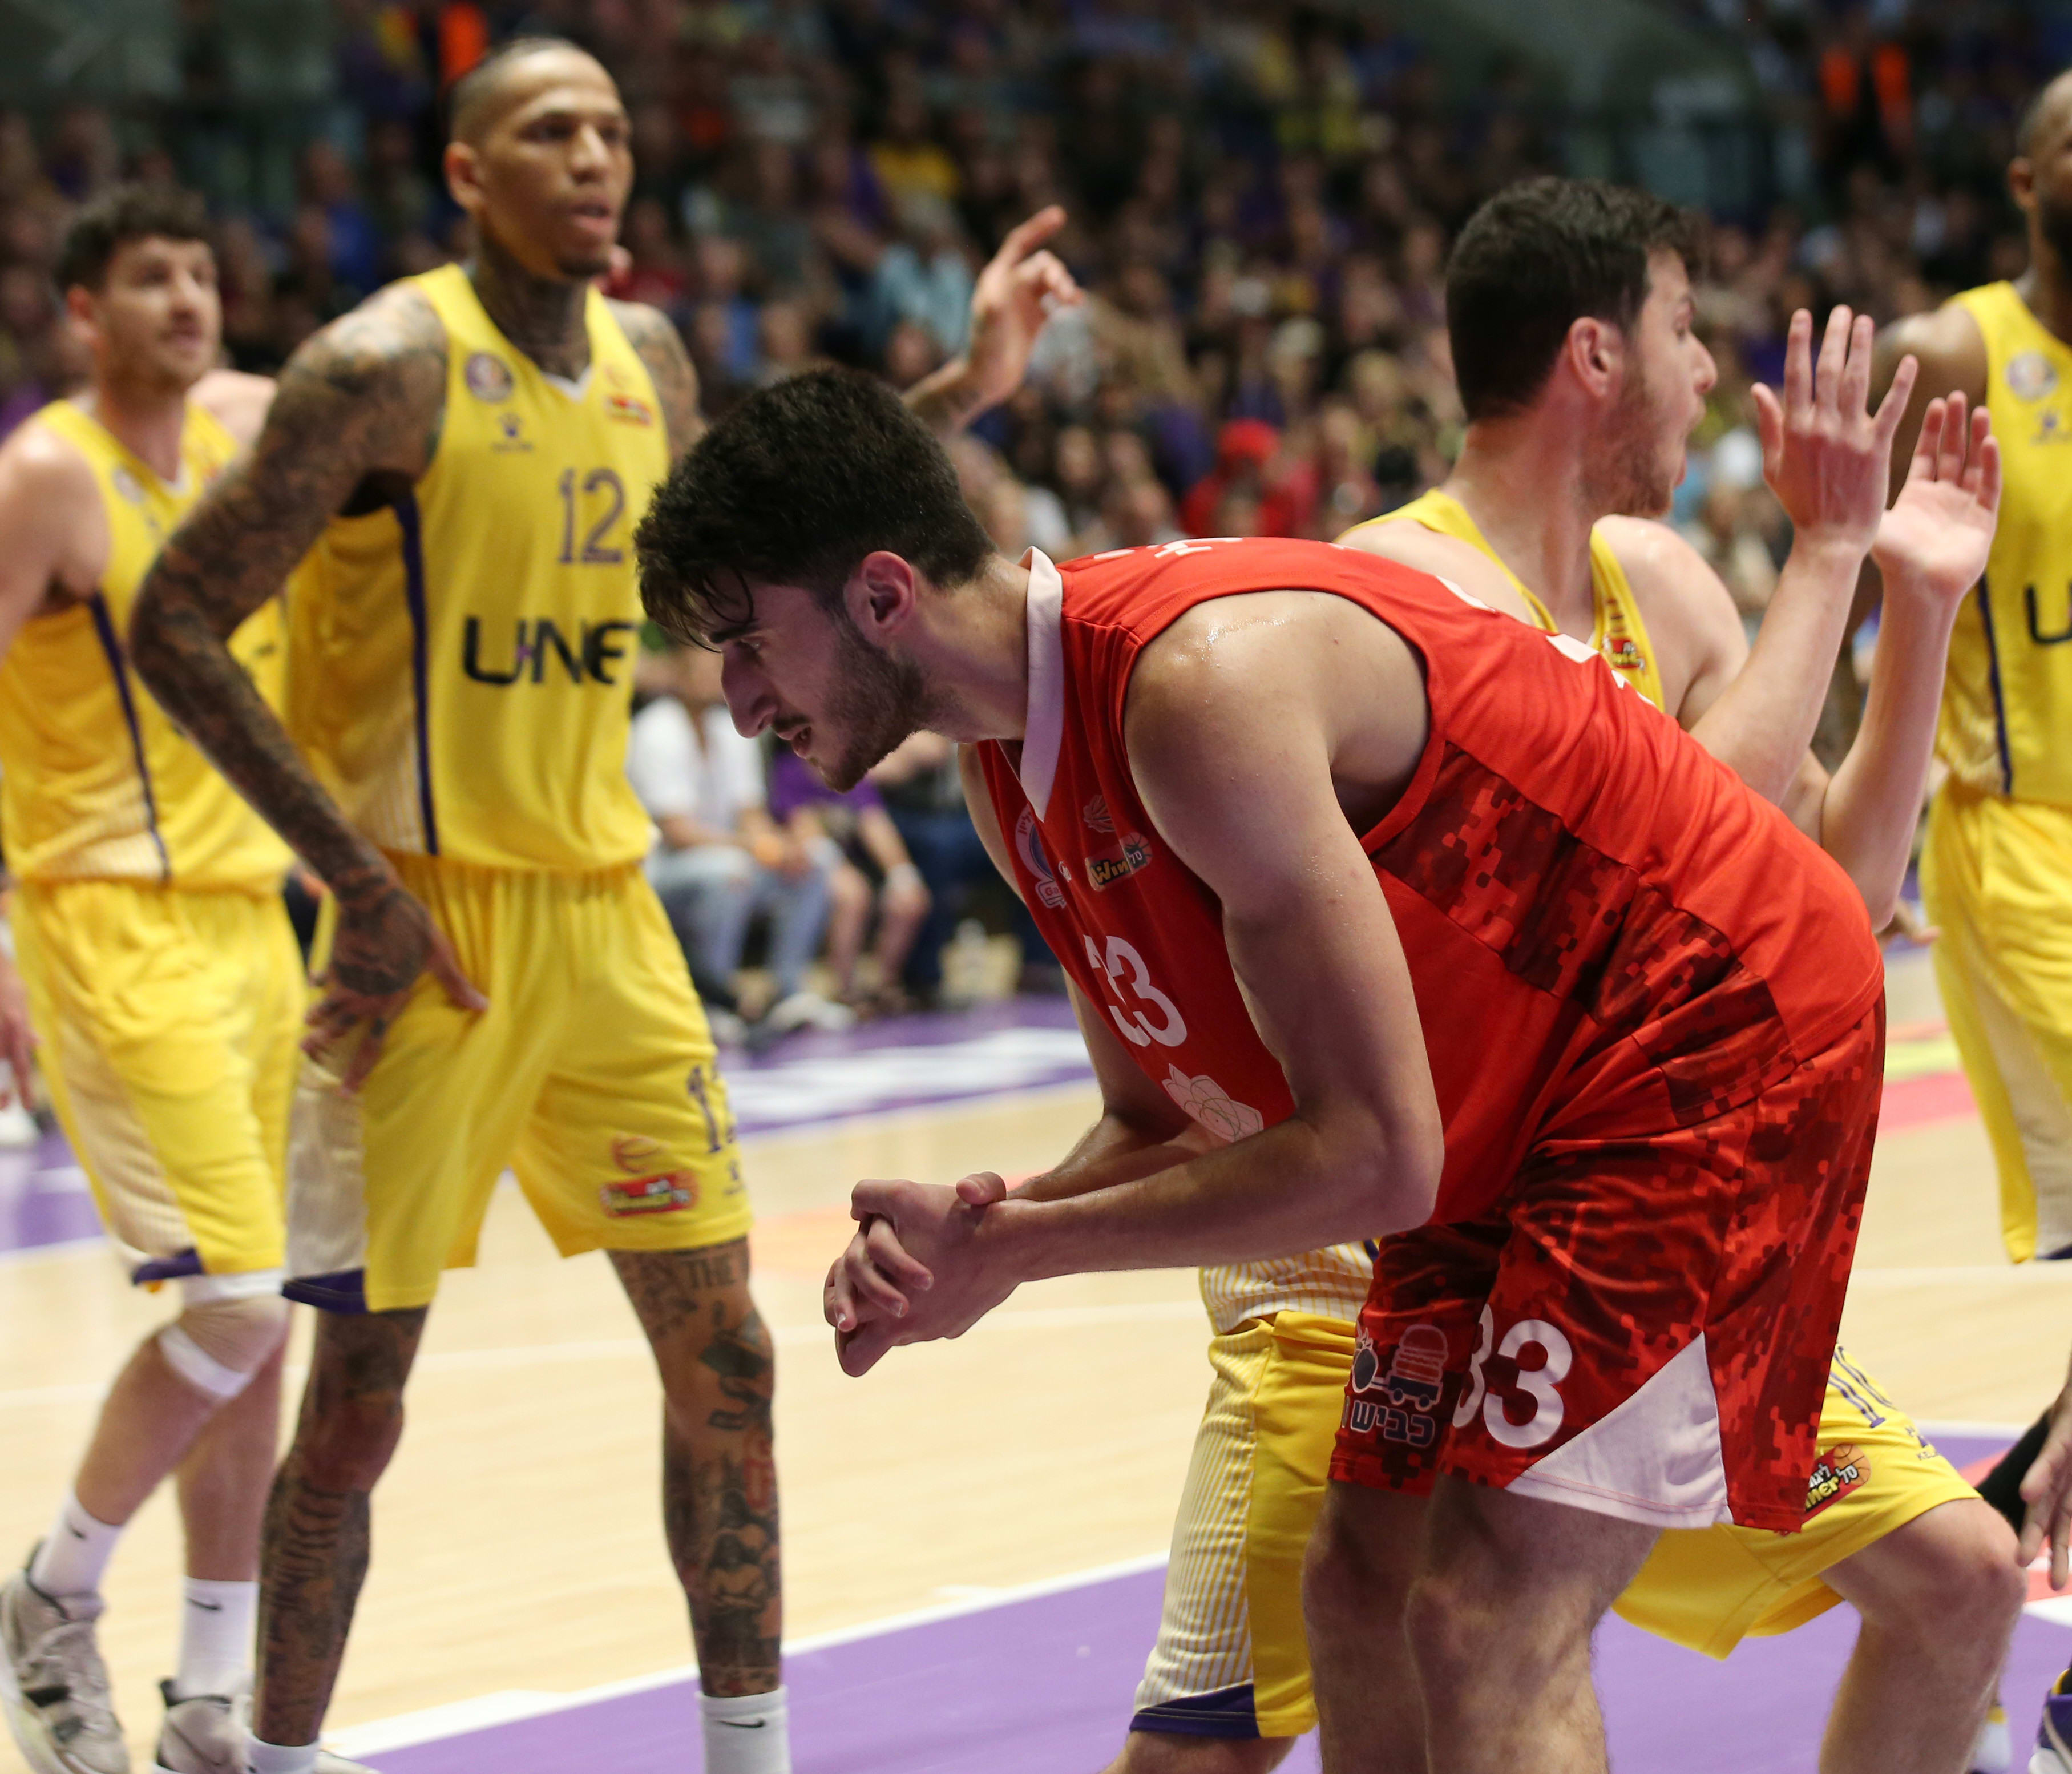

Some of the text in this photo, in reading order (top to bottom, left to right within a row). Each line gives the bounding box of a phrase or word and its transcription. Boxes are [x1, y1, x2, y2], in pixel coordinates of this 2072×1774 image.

[559, 467, 624, 565] 12
[1350, 1400, 1436, 1448] כביש
[1452, 1303, 1573, 1449] 33
